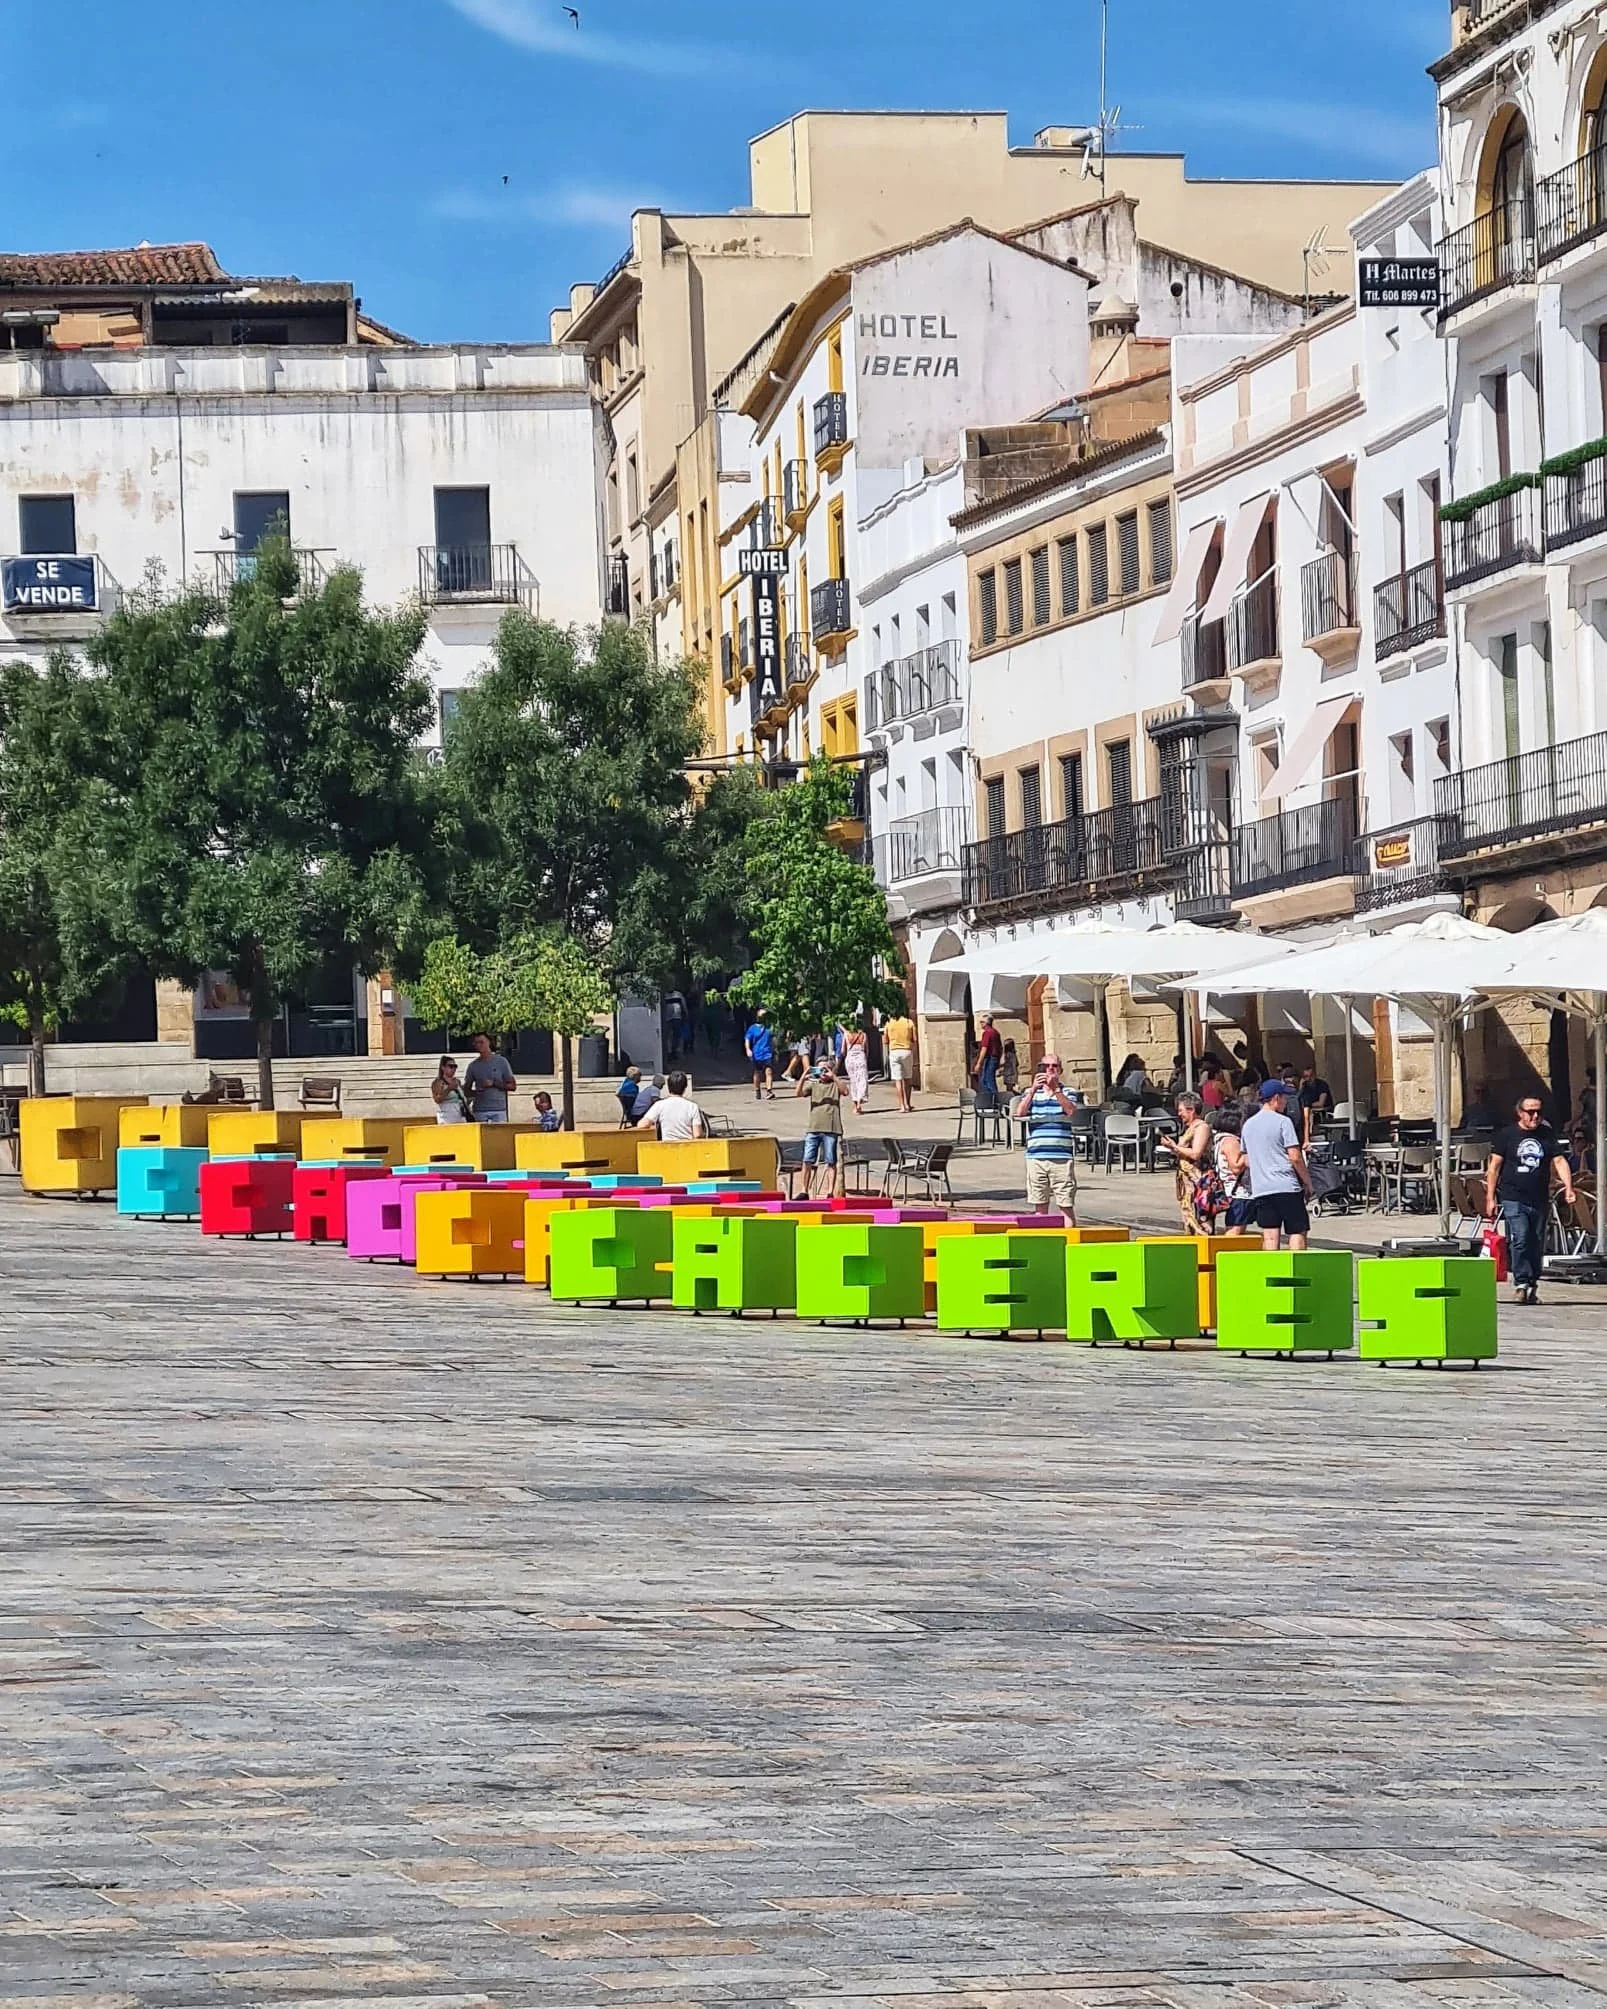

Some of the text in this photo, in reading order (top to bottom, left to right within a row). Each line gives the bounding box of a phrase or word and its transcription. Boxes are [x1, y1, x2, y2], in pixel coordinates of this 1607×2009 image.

[1401, 289, 1418, 301] 899
[1420, 289, 1437, 301] 473
[860, 313, 958, 339] HOTEL
[861, 355, 959, 377] IBERIA
[833, 393, 841, 440] HOTEL
[36, 561, 60, 578] SE
[740, 551, 788, 572] HOTEL
[15, 586, 83, 604] VENDE
[835, 580, 844, 626] HOTEL
[758, 578, 777, 696] IBERIA
